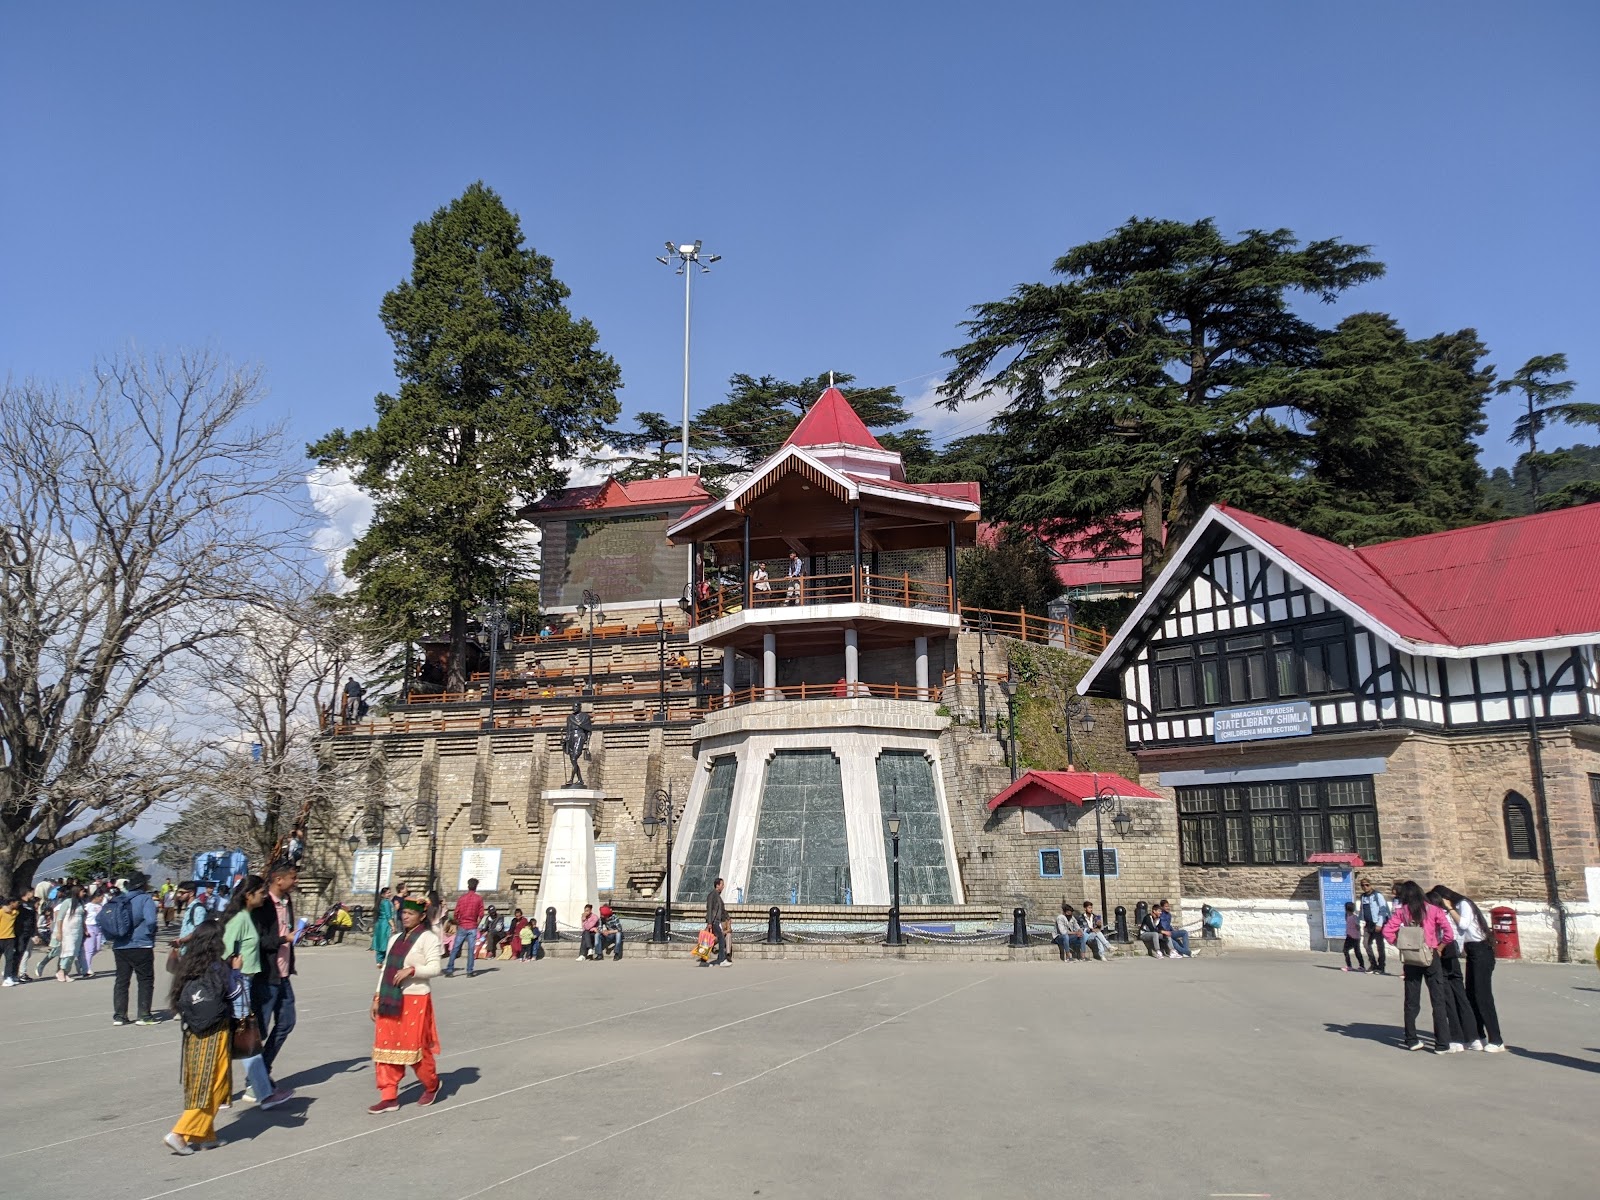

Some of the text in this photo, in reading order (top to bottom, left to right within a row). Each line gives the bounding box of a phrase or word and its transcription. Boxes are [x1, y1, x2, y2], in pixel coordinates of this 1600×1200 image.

[1231, 706, 1294, 719] HIMACHAL PRADESH
[1216, 711, 1309, 731] STATE LIBRARY SHIMLA
[1257, 727, 1272, 735] MAIN
